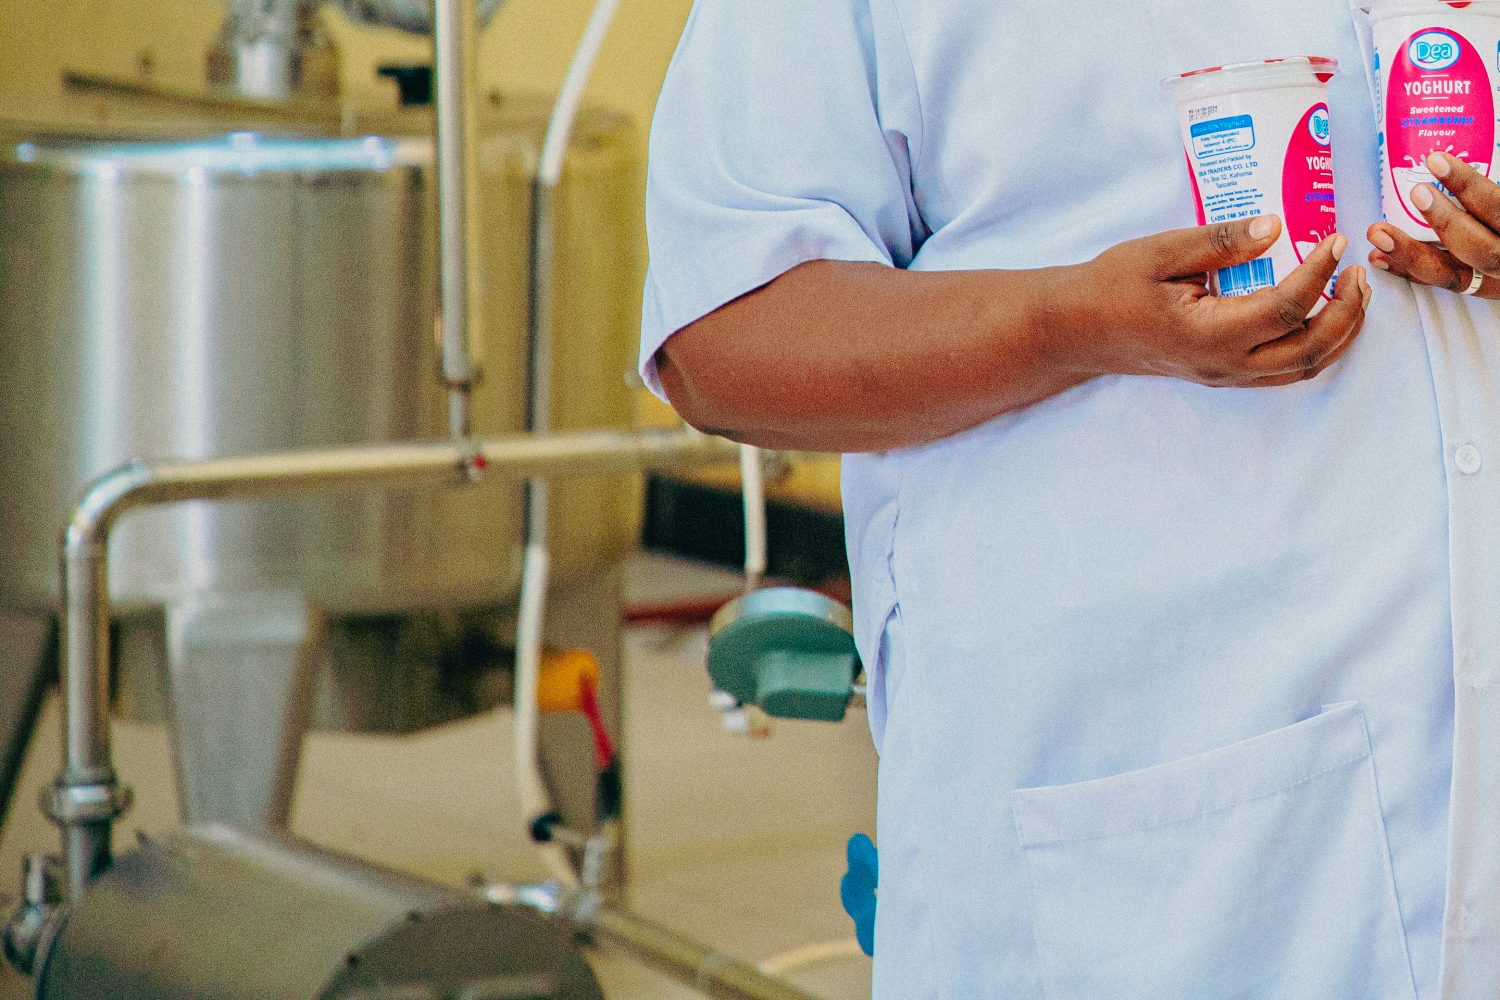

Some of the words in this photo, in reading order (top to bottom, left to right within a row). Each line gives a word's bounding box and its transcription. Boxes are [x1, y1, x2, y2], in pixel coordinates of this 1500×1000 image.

[1416, 42, 1453, 59] Dea
[1404, 80, 1471, 96] YOGHURT
[1410, 105, 1464, 115] Sweetened
[1402, 116, 1474, 127] STRAWBERRY
[1418, 129, 1456, 137] Flavour
[1208, 166, 1231, 174] TRADERS
